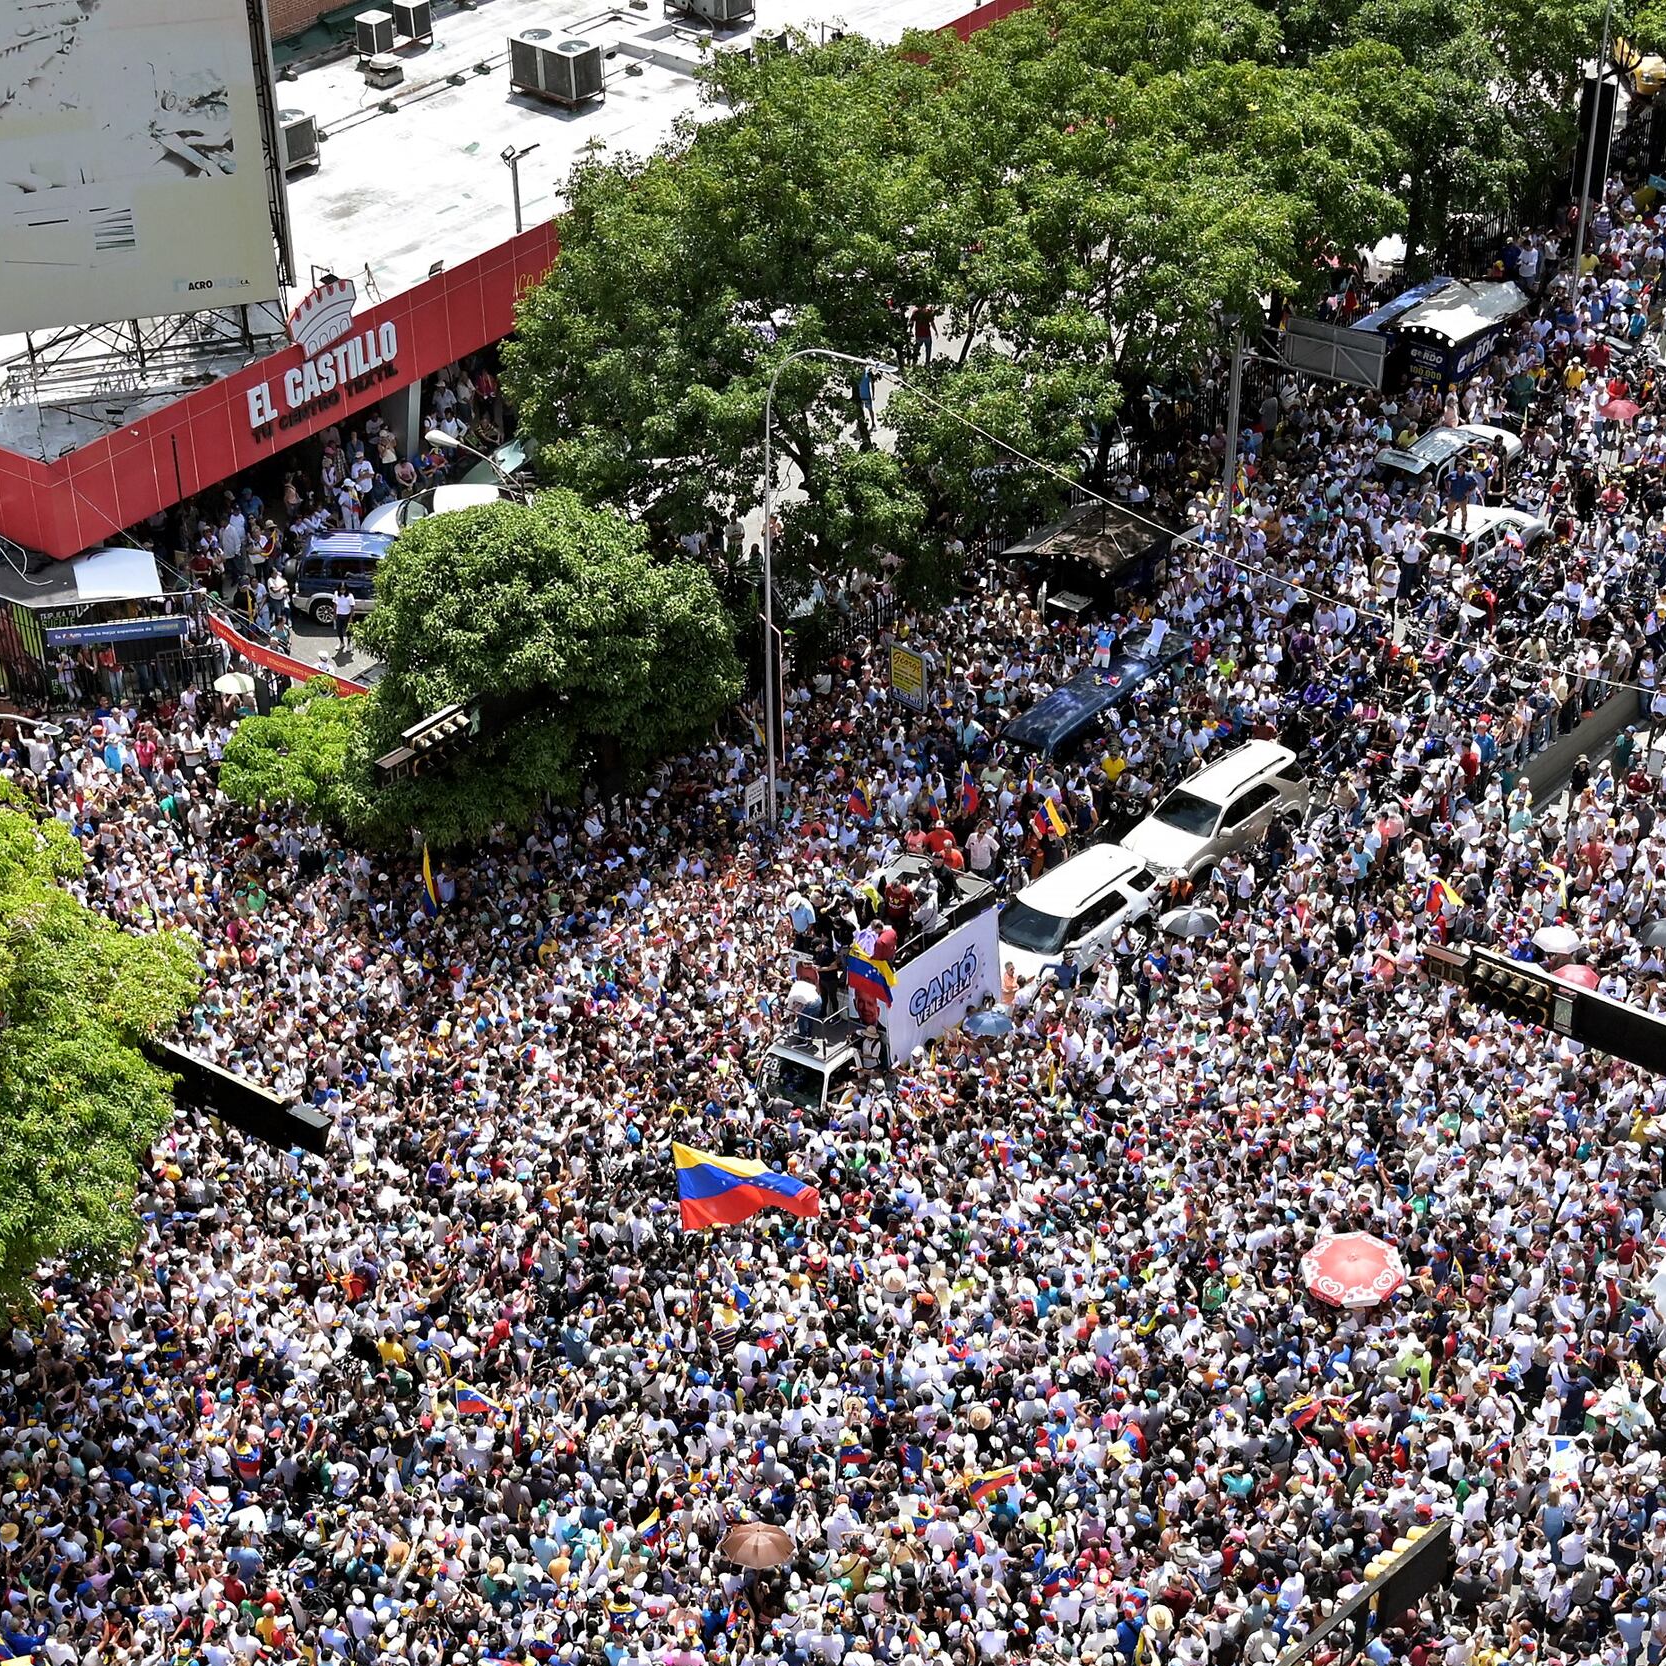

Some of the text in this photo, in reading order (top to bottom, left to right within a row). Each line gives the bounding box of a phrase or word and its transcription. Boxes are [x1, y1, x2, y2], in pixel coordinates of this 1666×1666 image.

[246, 321, 398, 429] EL CASTILLO
[278, 390, 340, 431] CENTRO
[909, 943, 977, 1017] GANÓ
[915, 974, 974, 1027] VENEZUELA
[764, 1056, 779, 1070] 28
